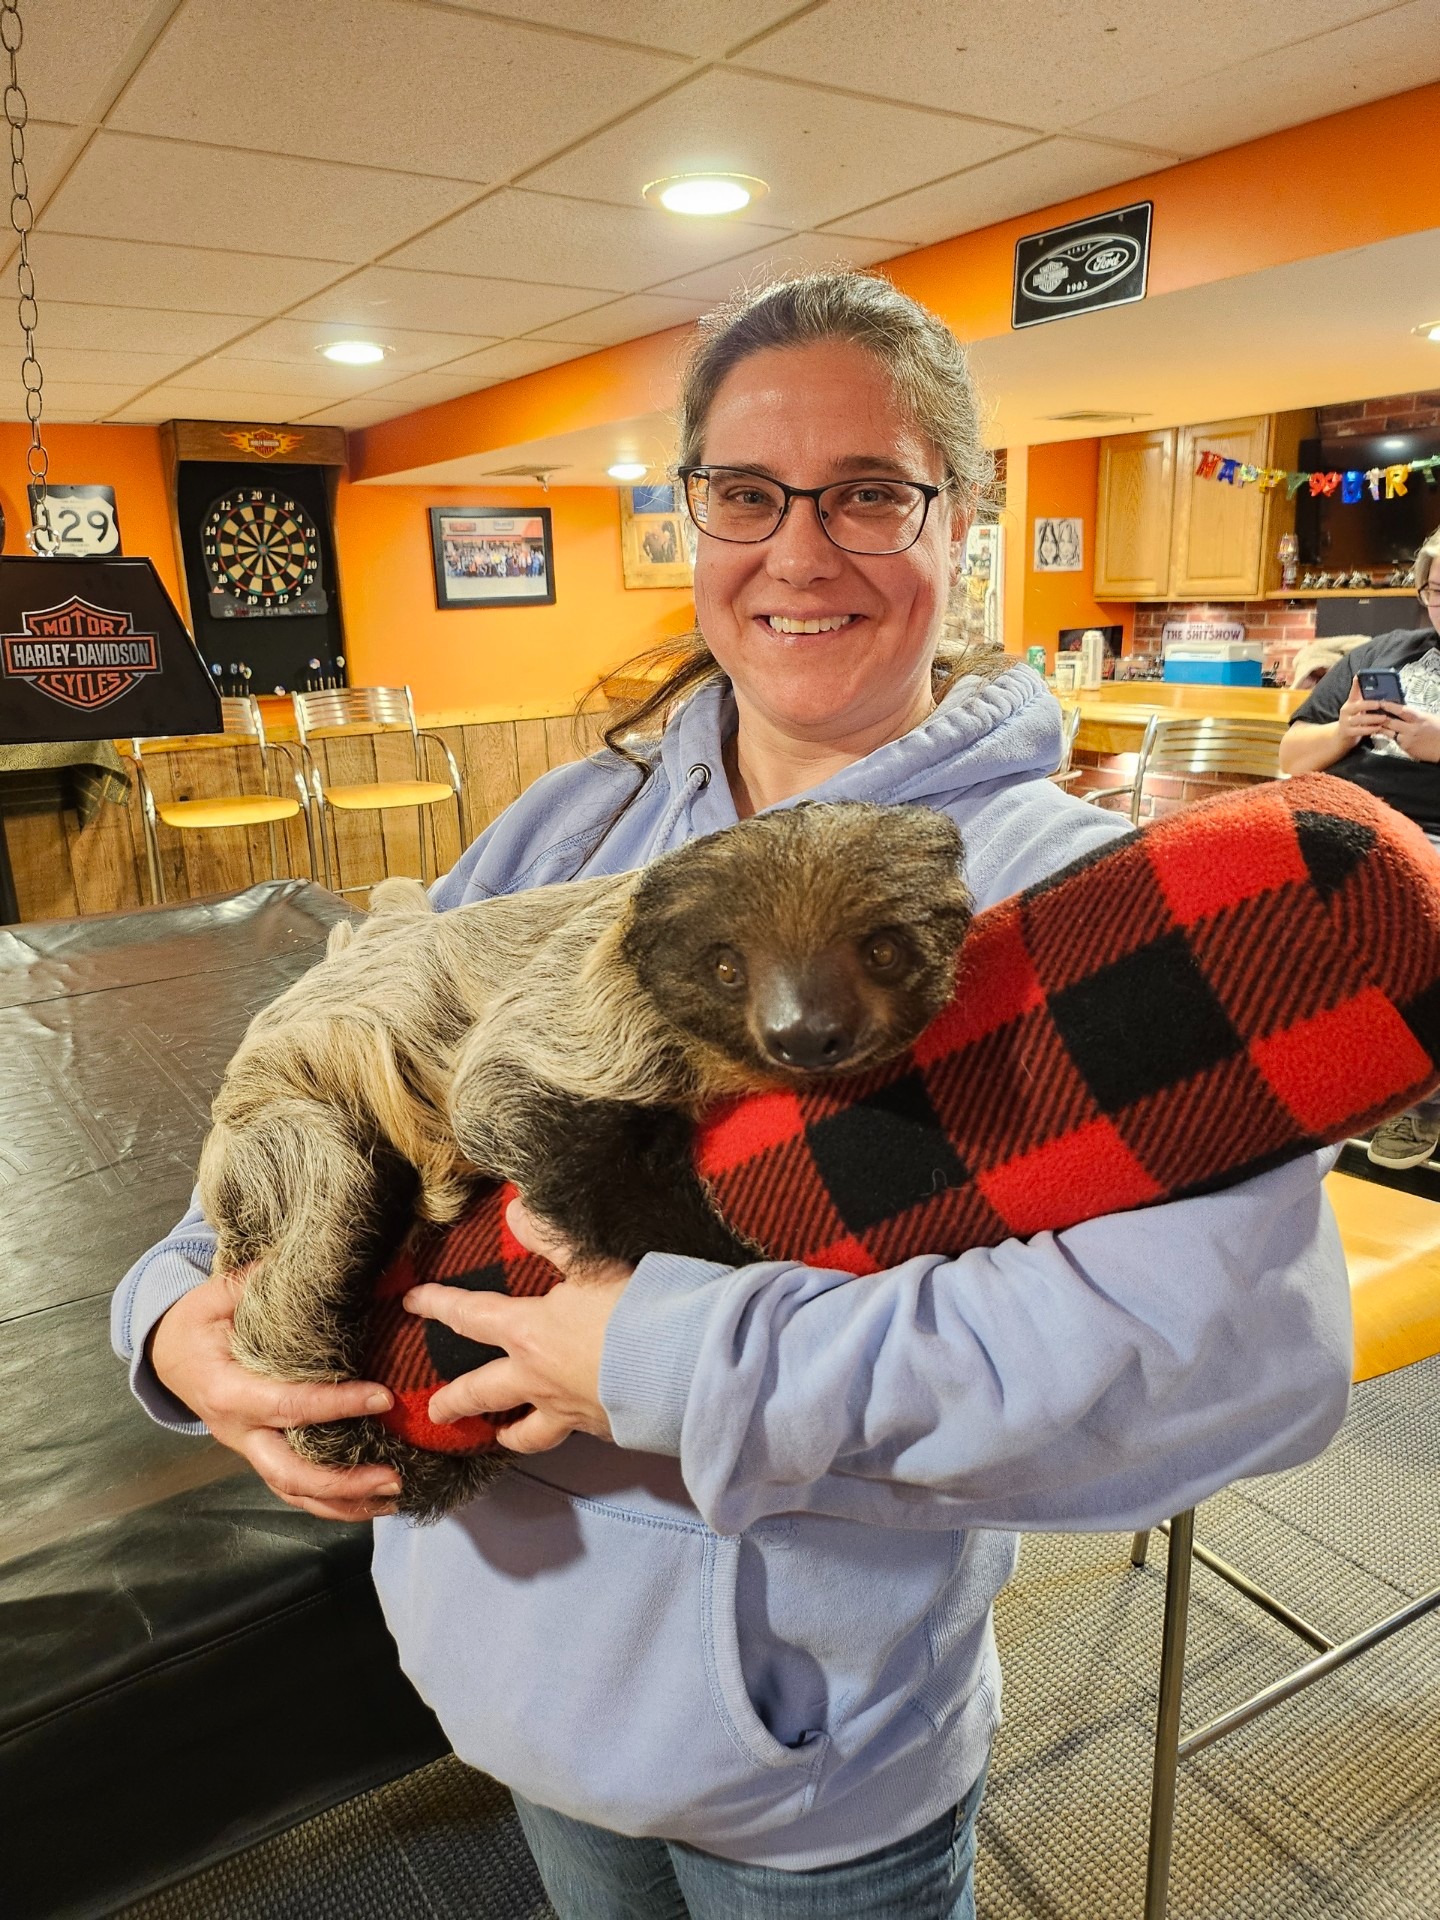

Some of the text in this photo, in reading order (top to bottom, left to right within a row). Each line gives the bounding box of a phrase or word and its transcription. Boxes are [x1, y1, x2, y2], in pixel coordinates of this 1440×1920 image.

[1093, 252, 1120, 271] Ford
[251, 490, 262, 500] 20
[271, 494, 276, 502] 1
[221, 501, 231, 510] 12
[284, 501, 294, 510] 18
[213, 513, 220, 521] 9
[297, 514, 302, 523] 4
[42, 510, 109, 542] 129
[205, 526, 216, 535] 14
[306, 528, 315, 537] 13
[206, 546, 216, 554] 11
[309, 545, 315, 553] 6
[307, 560, 317, 569] 10
[235, 589, 240, 597] 7
[295, 587, 301, 596] 2
[247, 596, 258, 605] 19
[265, 598, 271, 606] 3
[279, 594, 289, 603] 17
[44, 610, 115, 635] MOTOR
[1166, 630, 1240, 640] THE SHITSHOW
[13, 643, 150, 667] HARLEY-DAVIDSON
[51, 673, 121, 701] CYCLES
